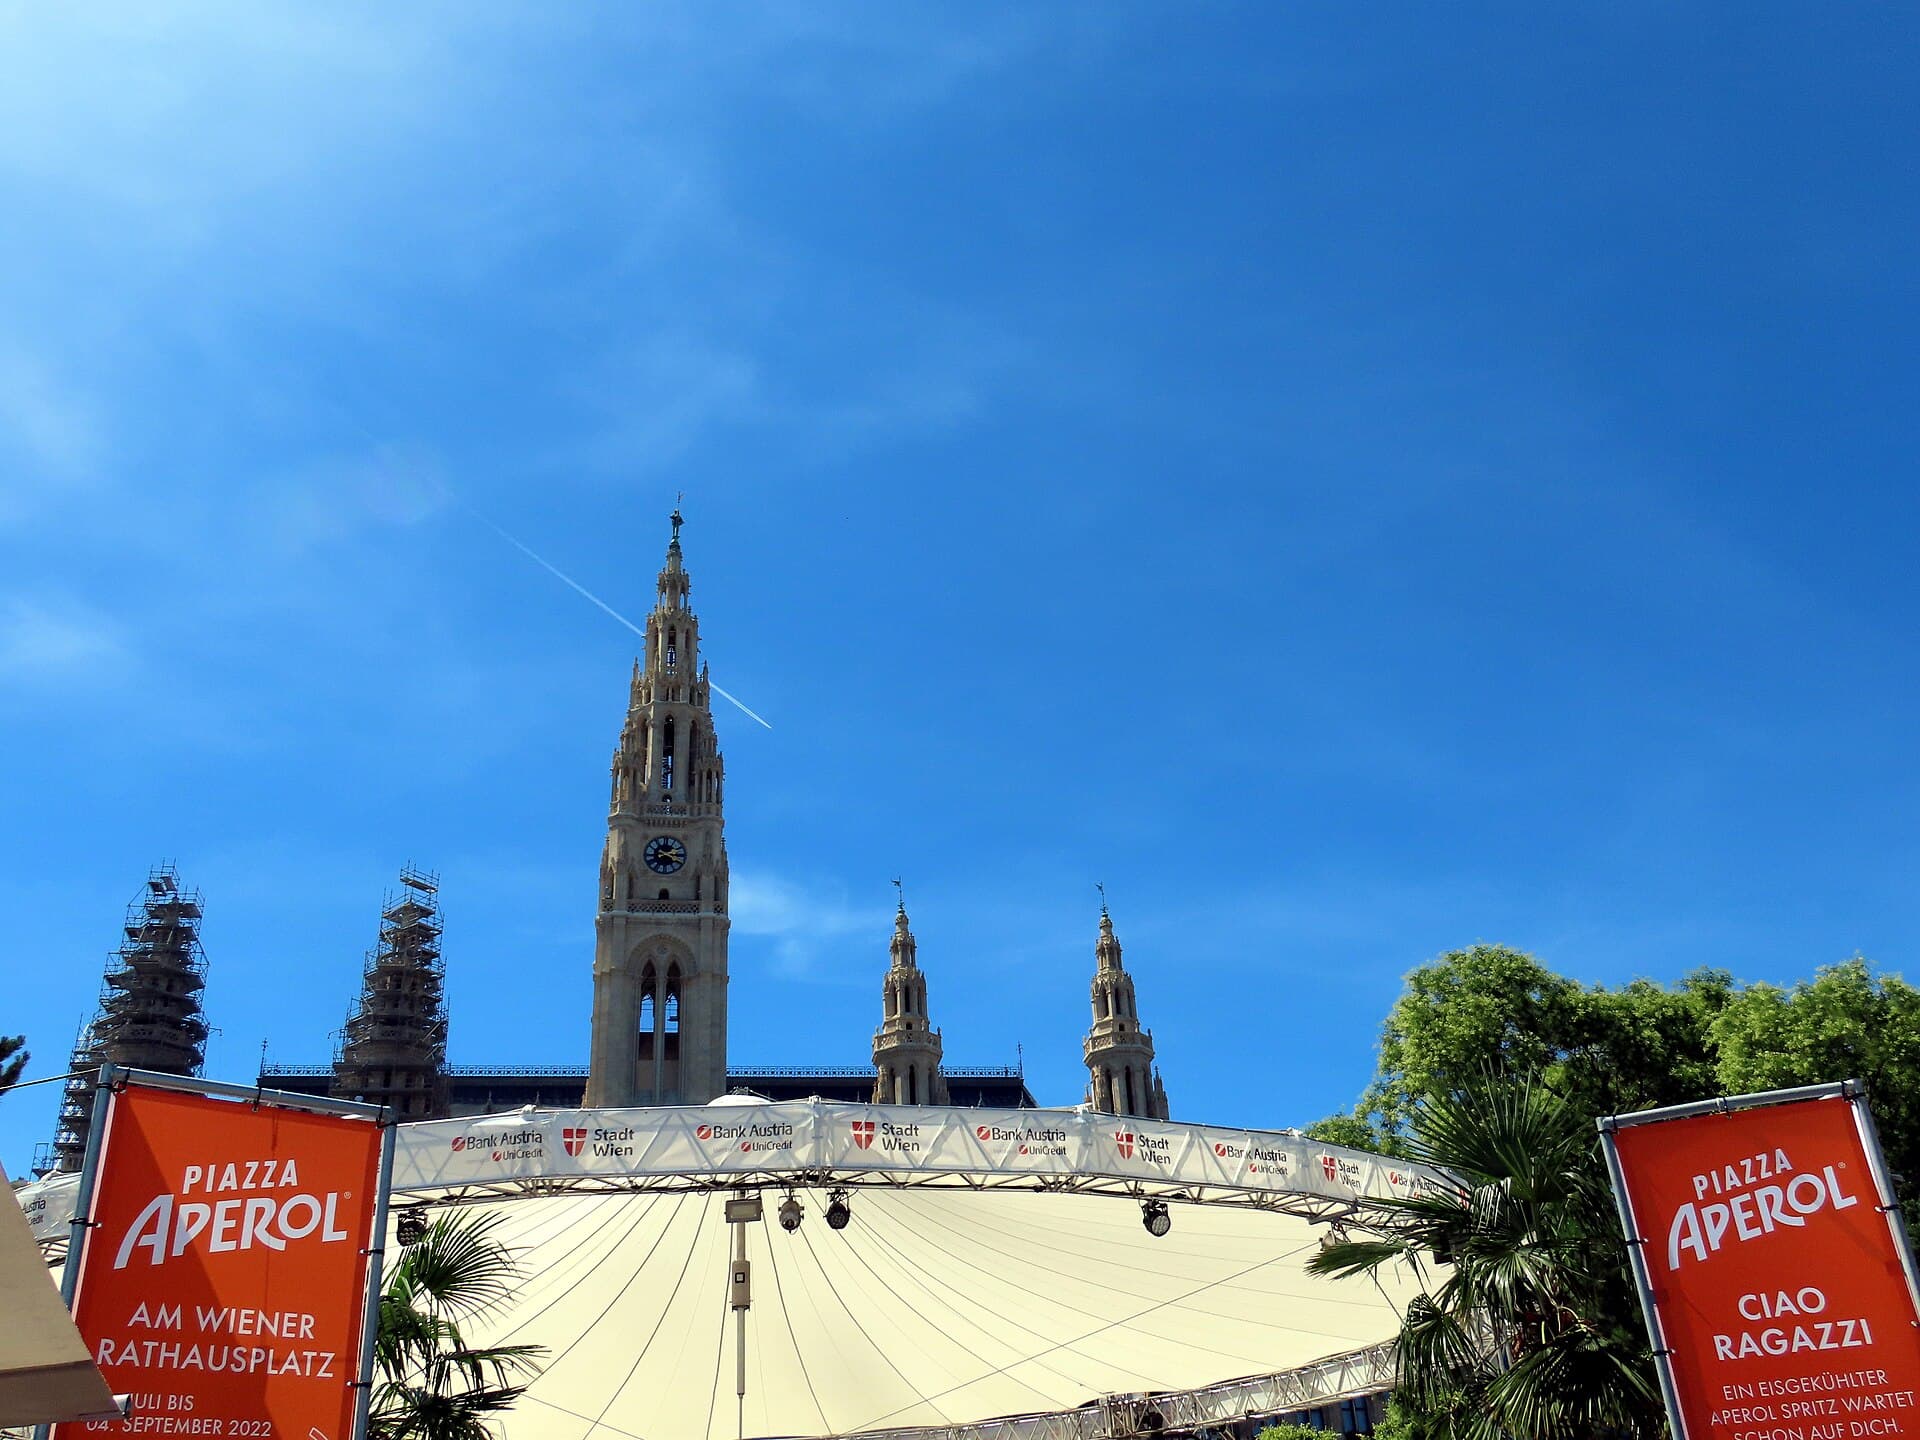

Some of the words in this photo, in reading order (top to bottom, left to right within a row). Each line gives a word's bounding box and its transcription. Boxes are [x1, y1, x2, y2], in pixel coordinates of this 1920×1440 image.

[594, 1127, 635, 1142] Stadt
[713, 1125, 746, 1139] Bank
[749, 1122, 793, 1137] Austria
[881, 1123, 919, 1137] Stadt
[991, 1127, 1023, 1141] Bank
[1025, 1128, 1066, 1142] Austria
[466, 1136, 497, 1150] Bank
[500, 1129, 543, 1146] Austria
[752, 1140, 793, 1152] UniCredit
[882, 1138, 920, 1152] Wien
[1138, 1135, 1169, 1150] Stadt
[502, 1150, 543, 1161] UniCredit
[593, 1143, 634, 1157] Wien
[1028, 1145, 1067, 1156] UniCredit
[1141, 1150, 1171, 1165] Wien
[1254, 1148, 1288, 1163] Austria
[1338, 1159, 1360, 1175] Stadt
[1693, 1148, 1793, 1200] PIAZZA
[183, 1159, 299, 1194] PIAZZA
[1340, 1173, 1361, 1190] Wien
[1668, 1165, 1858, 1272] APEROL
[113, 1192, 347, 1270] APEROL
[1737, 1286, 1827, 1322] CIAO
[128, 1302, 182, 1330] AM
[197, 1306, 315, 1339] WIENER
[1713, 1318, 1874, 1362] RAGAZZI
[97, 1338, 336, 1379] RATHAUSPLATZ
[1722, 1383, 1755, 1401] EIN
[1758, 1369, 1889, 1398] EISGEKÜHLTER
[167, 1395, 194, 1411] BIS
[1710, 1404, 1778, 1427] APEROL
[1780, 1399, 1840, 1420] SPRITZ
[1841, 1391, 1915, 1413] WARTET
[122, 1417, 222, 1435] SEPTEMBER
[228, 1420, 272, 1437] 2022
[1810, 1422, 1846, 1440] AUF
[1850, 1417, 1905, 1437] DICH.
